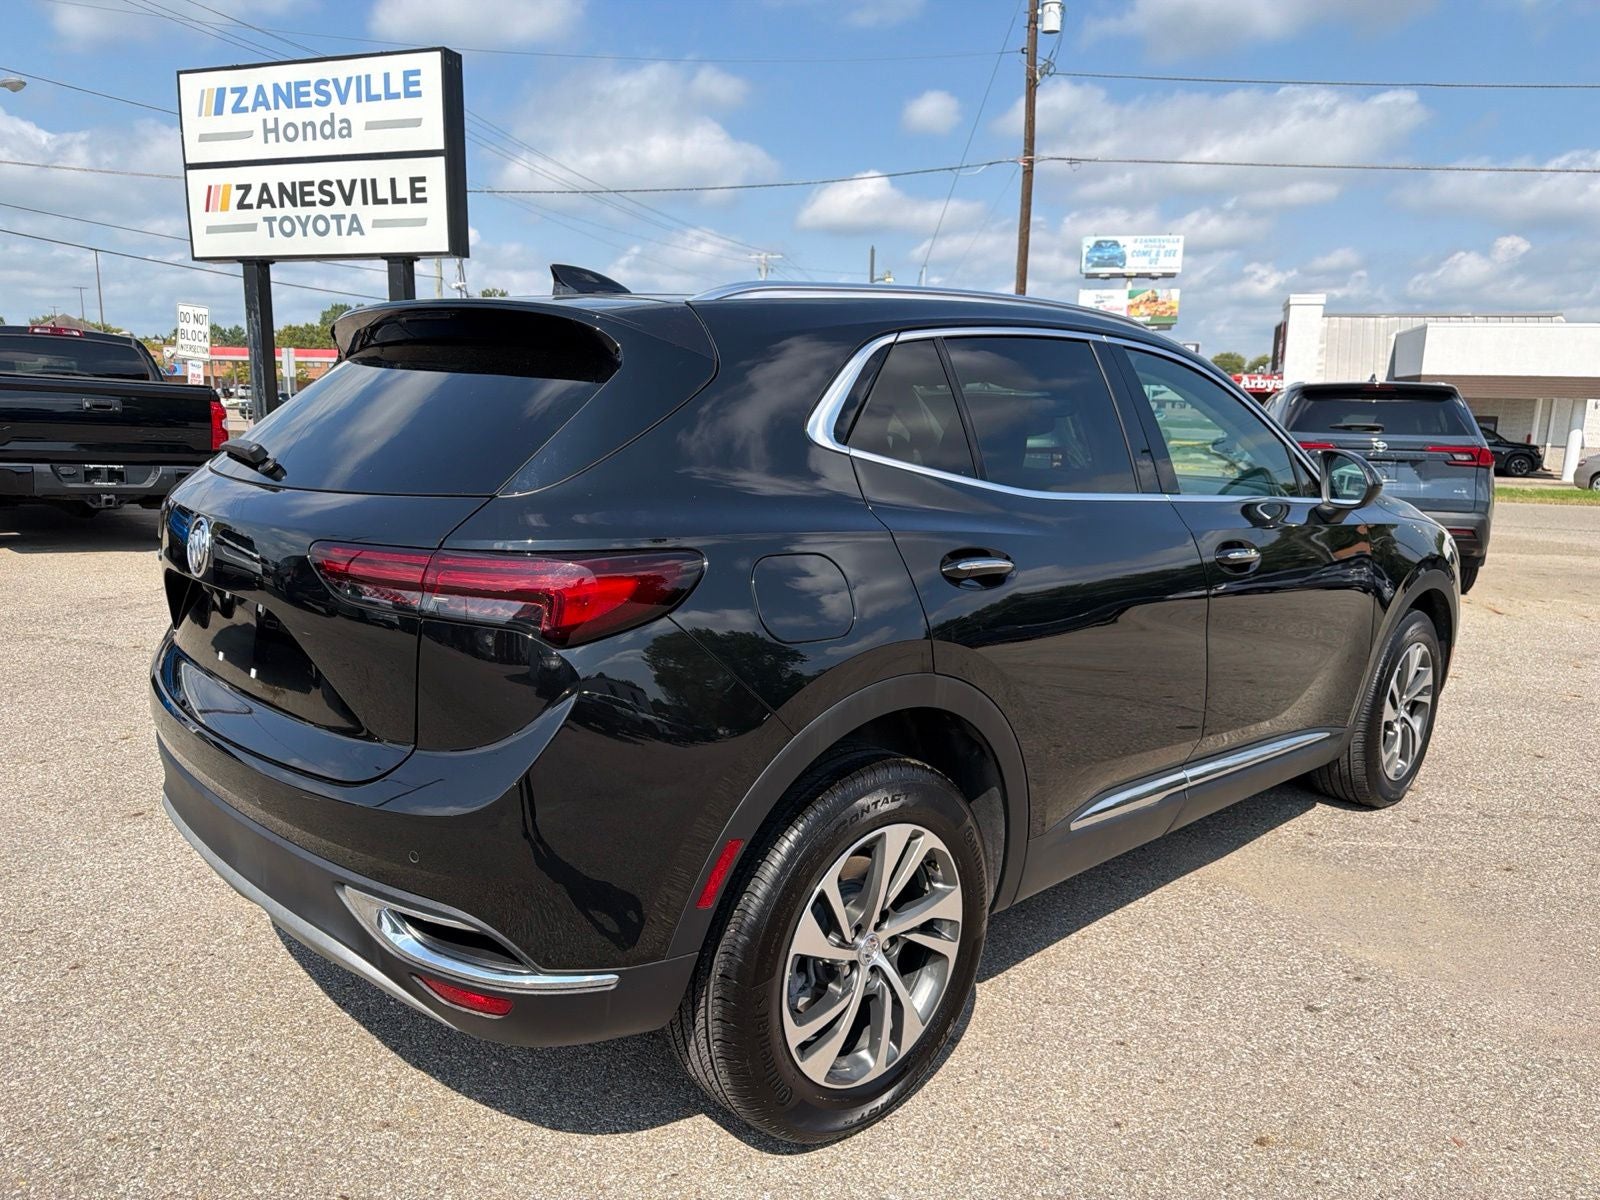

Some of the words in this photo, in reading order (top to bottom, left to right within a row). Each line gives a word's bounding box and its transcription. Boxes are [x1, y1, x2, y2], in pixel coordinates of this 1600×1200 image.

[231, 69, 422, 113] ZANESVILLE
[262, 112, 352, 144] Honda
[235, 176, 428, 210] ZANESVILLE
[263, 213, 365, 238] TOYOTA
[1131, 249, 1152, 258] COME
[1163, 248, 1178, 258] SEE
[1148, 257, 1160, 265] US
[180, 312, 190, 323] DO
[193, 313, 208, 327] NOT
[180, 328, 208, 343] BLOCK
[178, 342, 208, 354] INTERSECTION
[1240, 374, 1283, 392] Arby's
